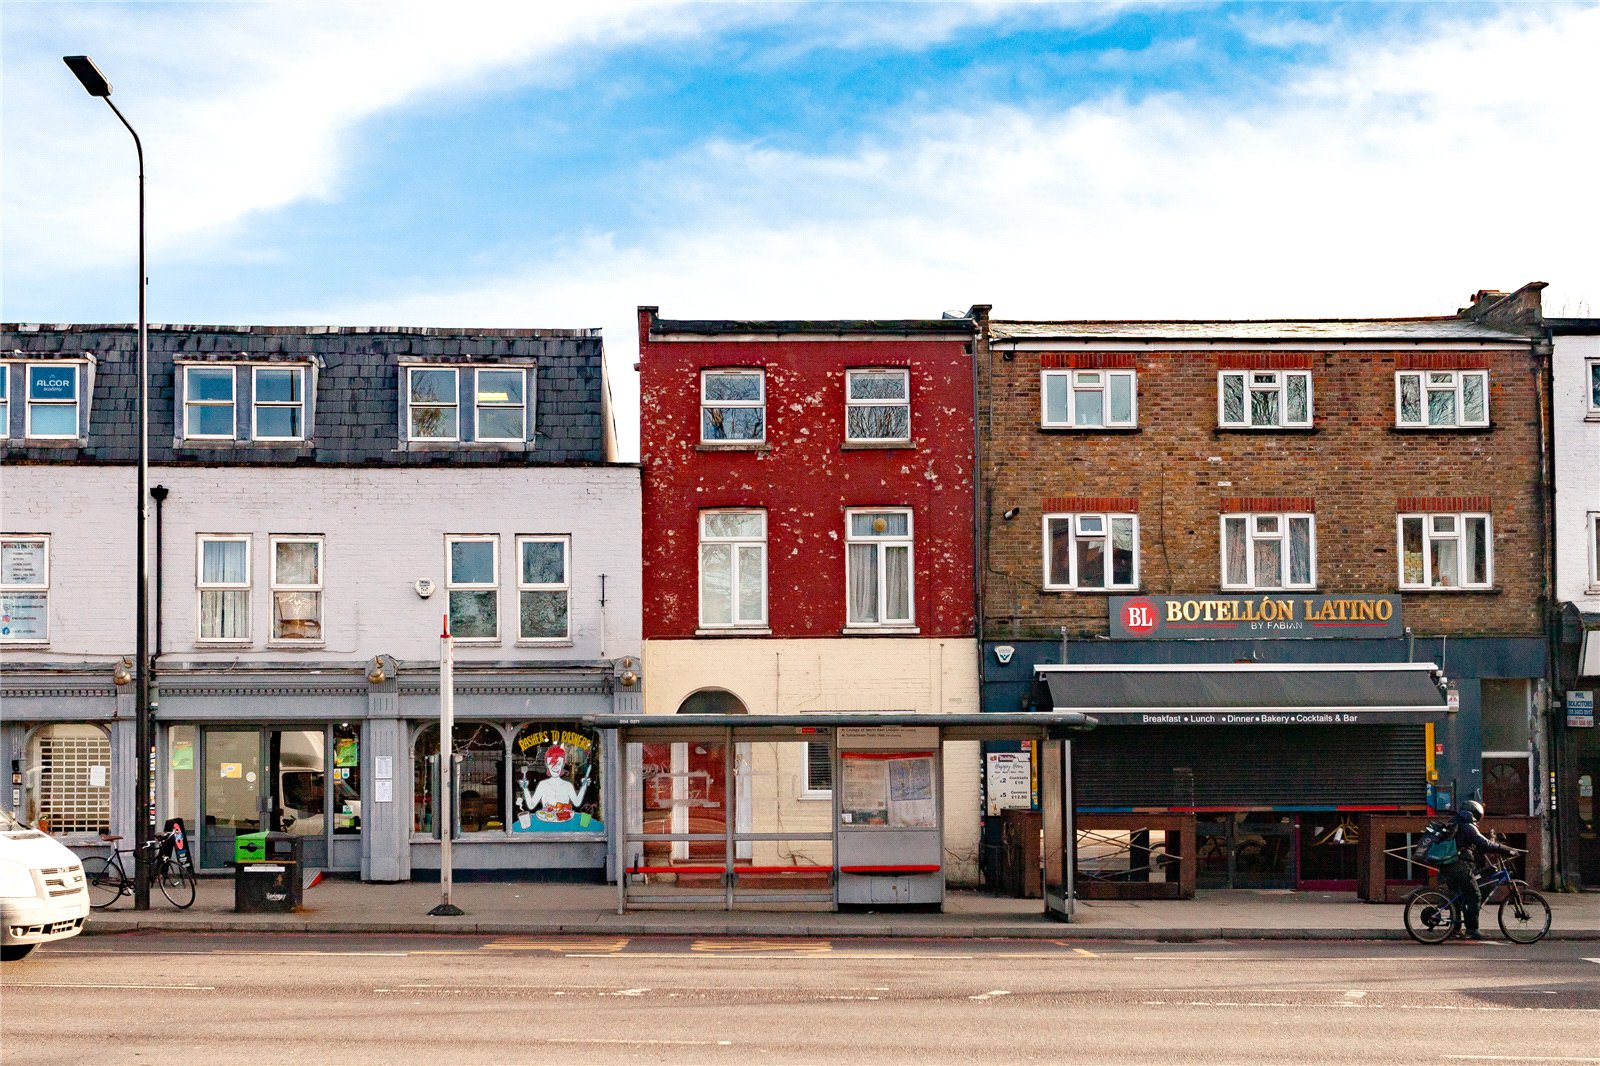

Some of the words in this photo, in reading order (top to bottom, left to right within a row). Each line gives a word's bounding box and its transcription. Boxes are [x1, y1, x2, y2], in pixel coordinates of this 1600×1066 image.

[36, 379, 70, 387] ALCOR
[1165, 596, 1295, 621] BOTELLÓN
[1303, 599, 1393, 621] LATINO
[1128, 607, 1153, 627] BL
[1250, 622, 1263, 630] BY
[1267, 621, 1303, 630] FABIAN
[1142, 714, 1181, 722] Breakfast
[1190, 714, 1215, 722] Lunch
[1227, 714, 1254, 722] Dinner
[1261, 714, 1289, 724] Bakery
[1296, 714, 1333, 722] Cocktails
[1335, 714, 1341, 722] &
[1343, 714, 1358, 722] Bar
[518, 730, 548, 752] RASHERS
[550, 729, 560, 742] TO
[561, 730, 591, 751] RASHERS
